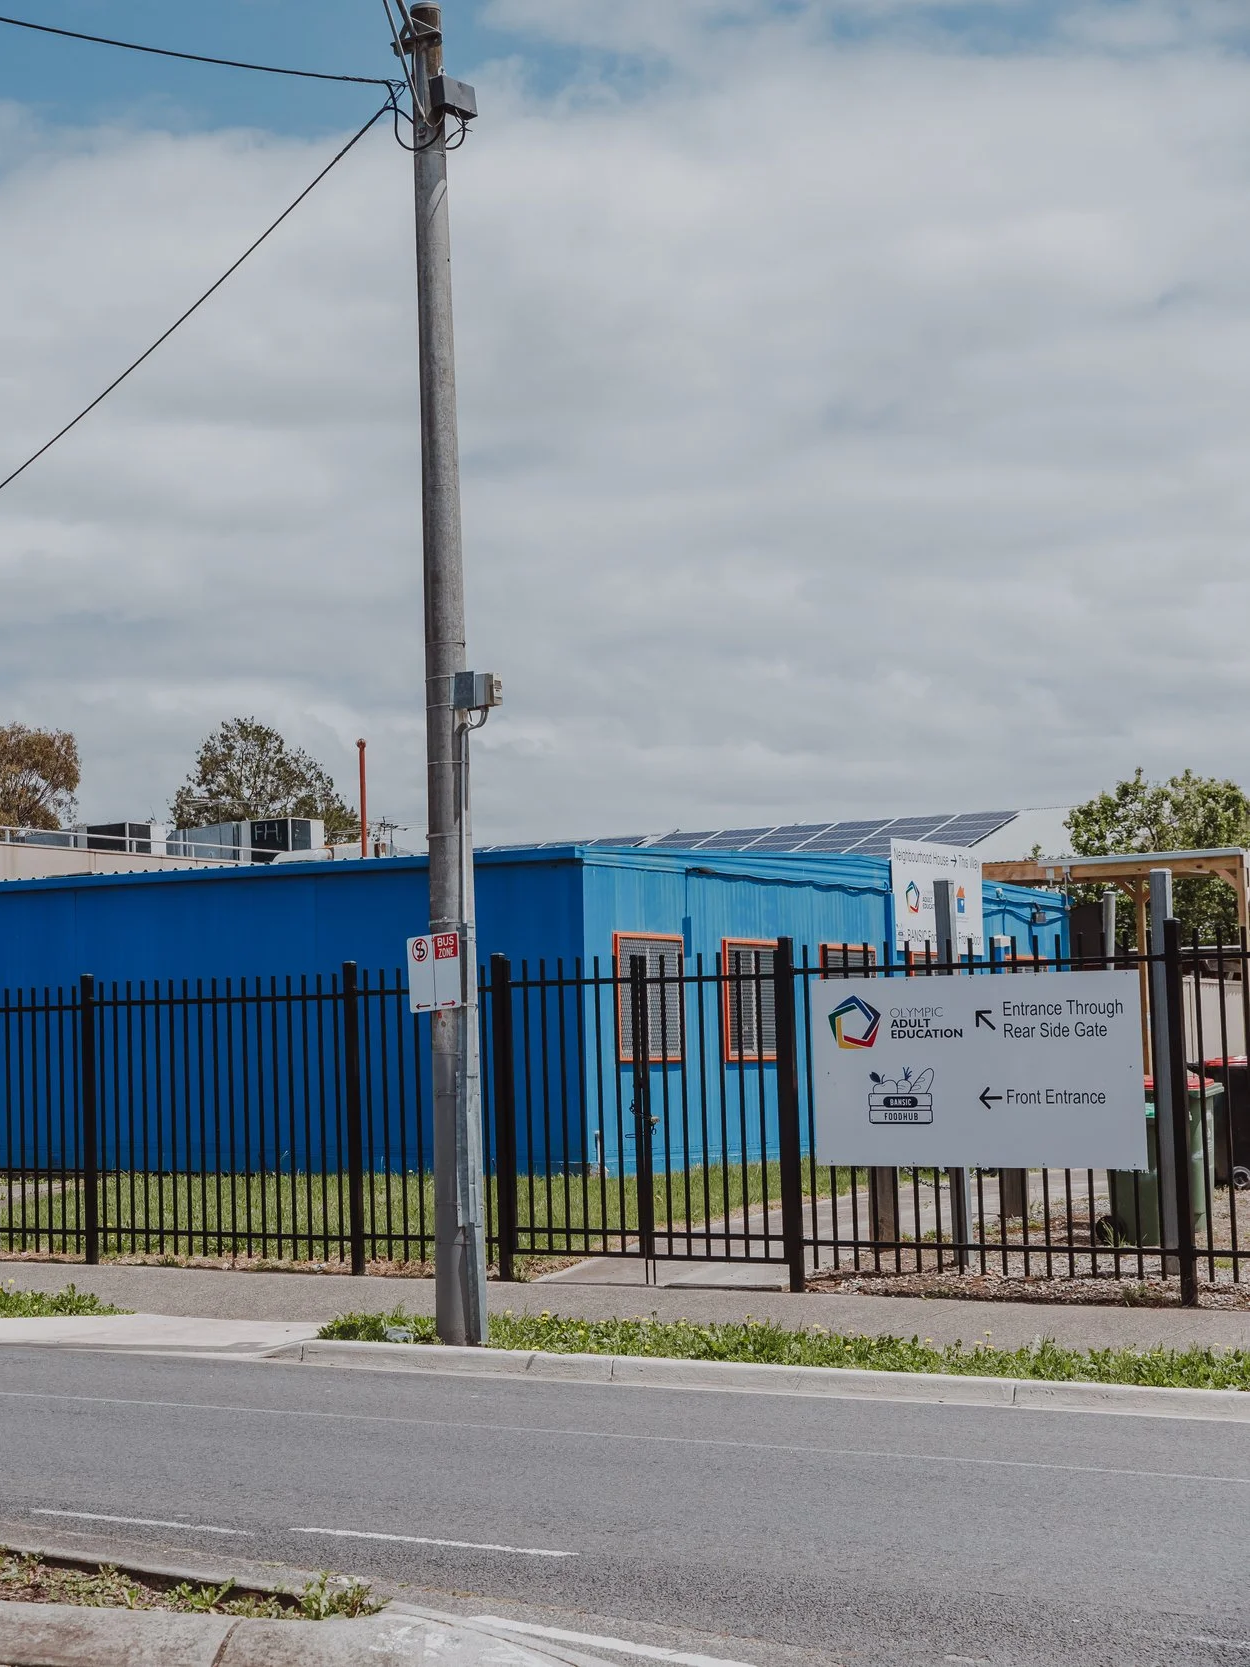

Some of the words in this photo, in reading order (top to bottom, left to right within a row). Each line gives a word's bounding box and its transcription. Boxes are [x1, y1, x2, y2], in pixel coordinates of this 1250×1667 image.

[933, 851, 950, 866] House
[958, 854, 969, 868] This
[437, 935, 455, 947] BUS
[438, 946, 455, 958] ZONE
[890, 1006, 943, 1018] OLYMPIC
[1002, 1001, 1062, 1016] Entrance
[1066, 999, 1124, 1018] Through
[890, 1018, 931, 1028] ADULT
[891, 1028, 963, 1039] EDUCATION
[1003, 1023, 1036, 1038] Rear
[1040, 1022, 1070, 1038] Side
[1074, 1021, 1107, 1037] Gate
[889, 1098, 912, 1106] BANSIC
[1006, 1089, 1041, 1104] Front
[1045, 1089, 1106, 1104] Entrance
[884, 1112, 919, 1121] FOODHUB
